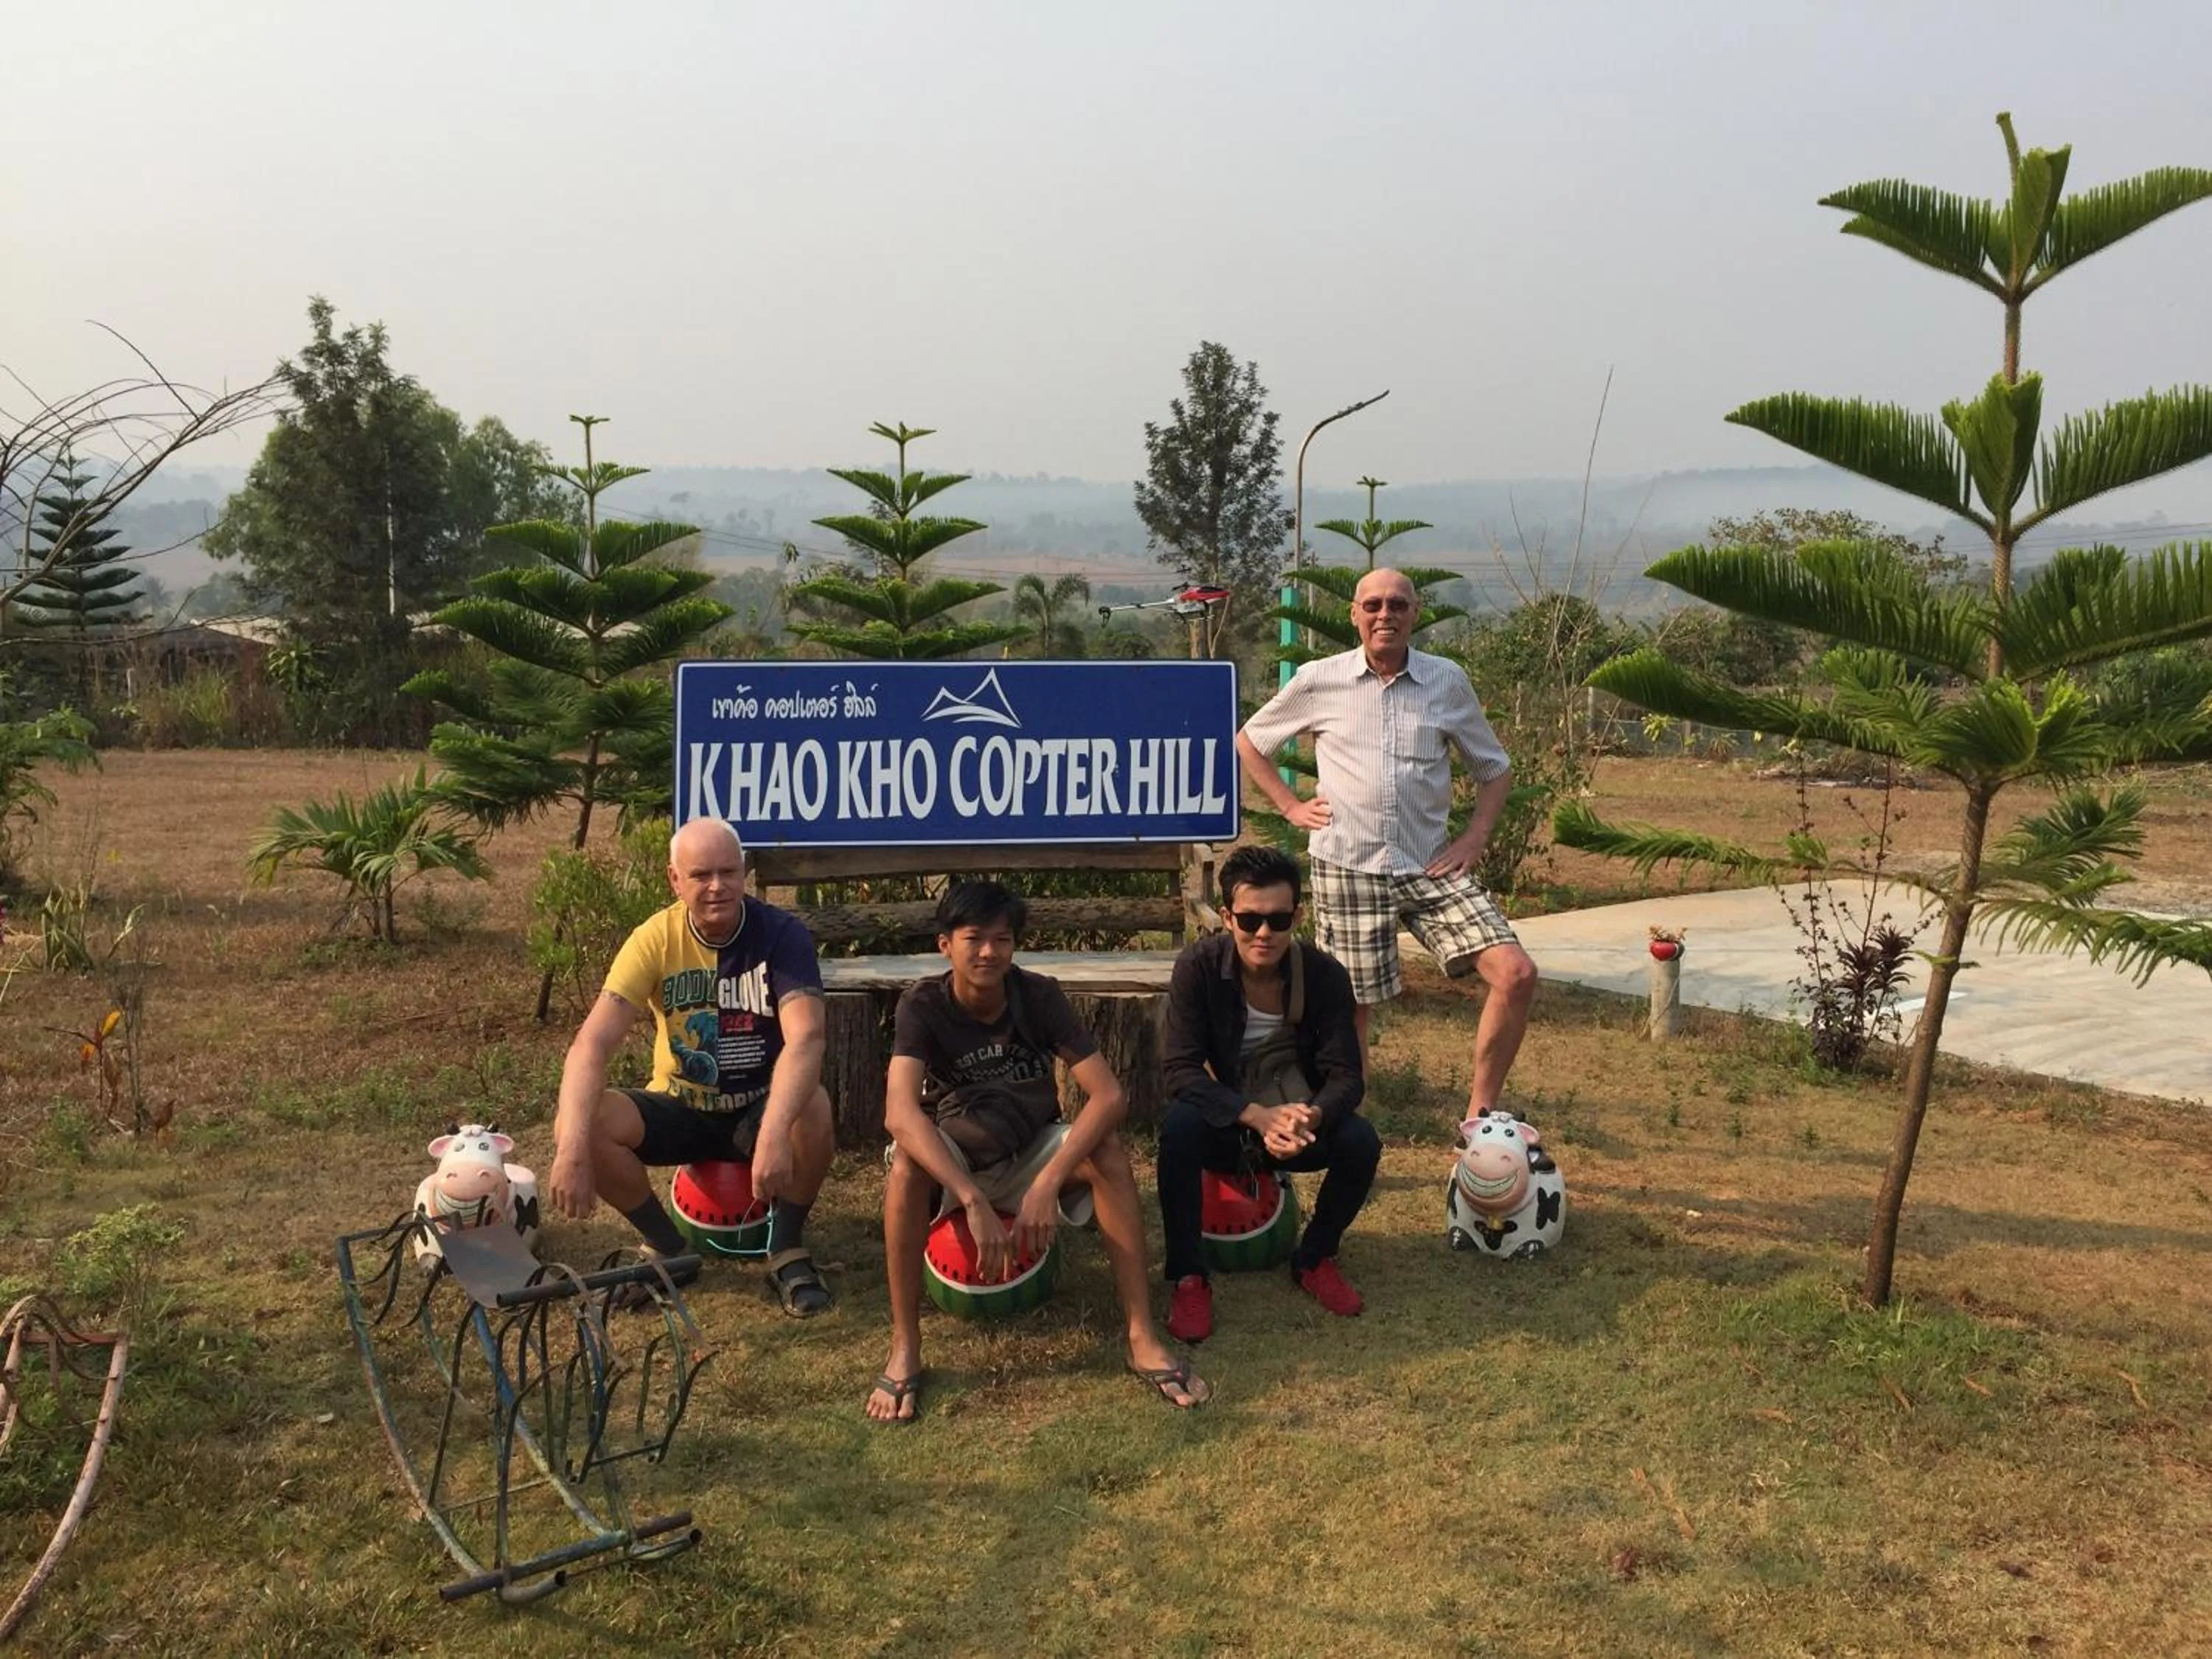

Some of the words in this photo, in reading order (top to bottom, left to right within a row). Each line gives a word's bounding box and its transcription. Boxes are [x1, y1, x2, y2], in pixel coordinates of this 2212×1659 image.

[688, 739, 827, 821] KHAO
[837, 737, 937, 819] KHO
[950, 736, 1121, 818] COPTER
[1127, 737, 1227, 815] HILL
[662, 967, 718, 1009] BODY
[718, 961, 774, 1018] GLOVE
[978, 1043, 1004, 1060] CAR
